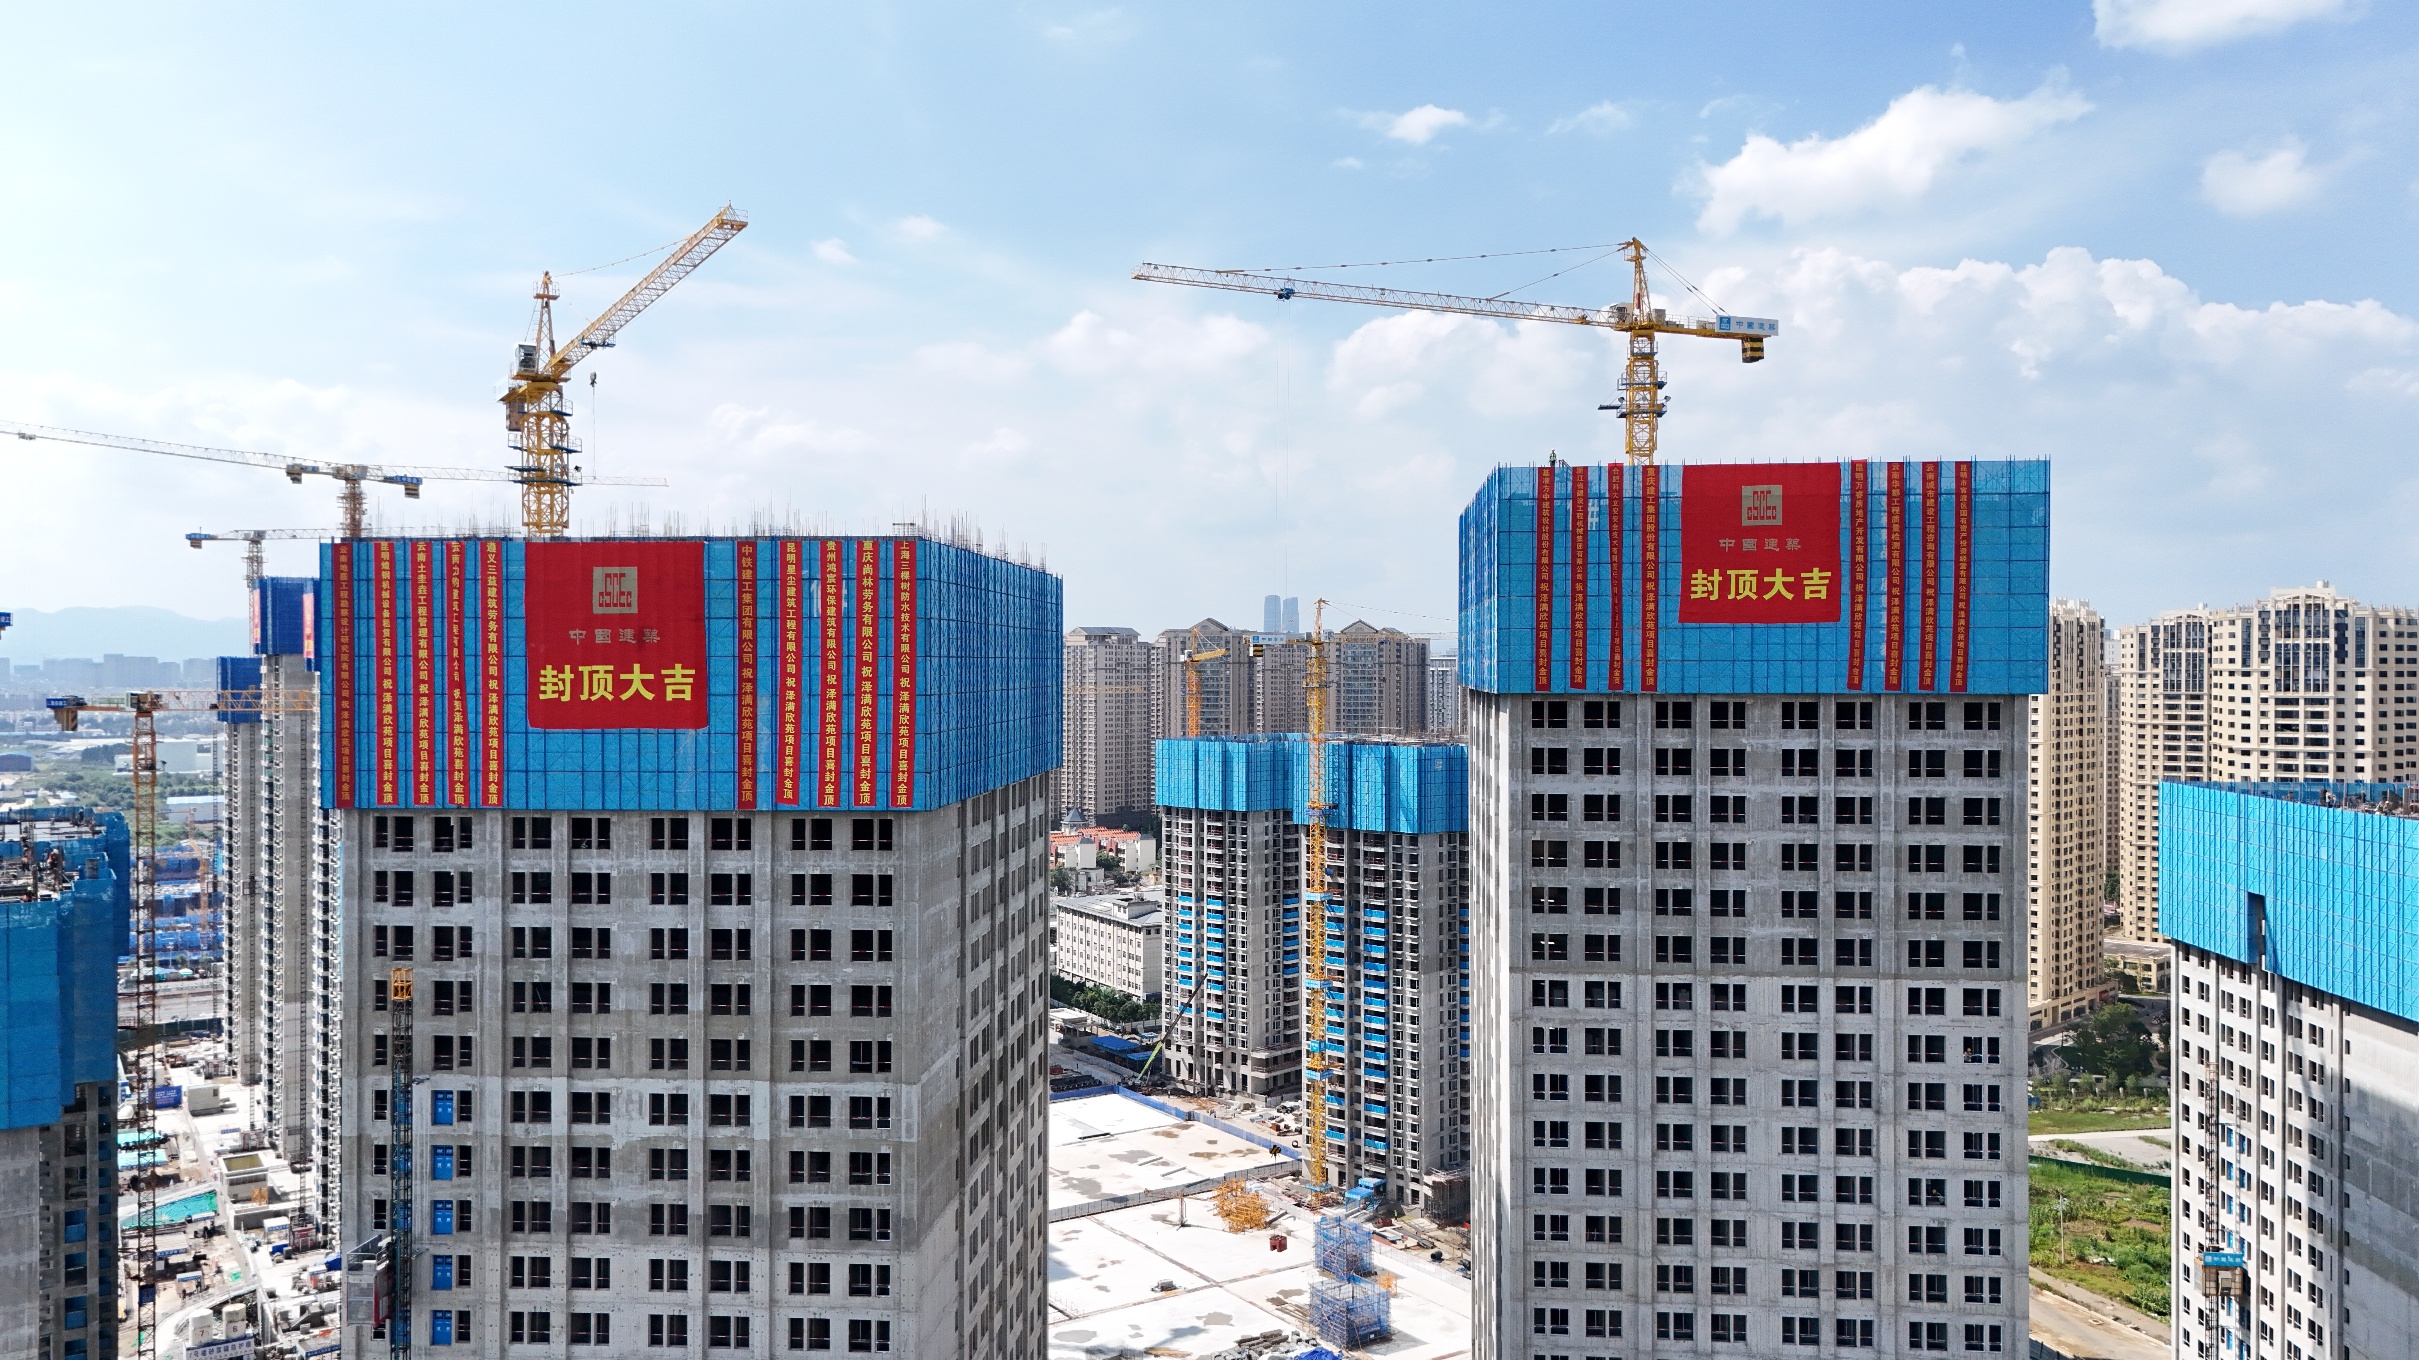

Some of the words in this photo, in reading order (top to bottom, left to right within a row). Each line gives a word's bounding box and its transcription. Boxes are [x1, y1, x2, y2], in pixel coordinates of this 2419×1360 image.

[1690, 567, 1831, 601] 封顶大吉
[538, 663, 696, 702] 封顶大吉
